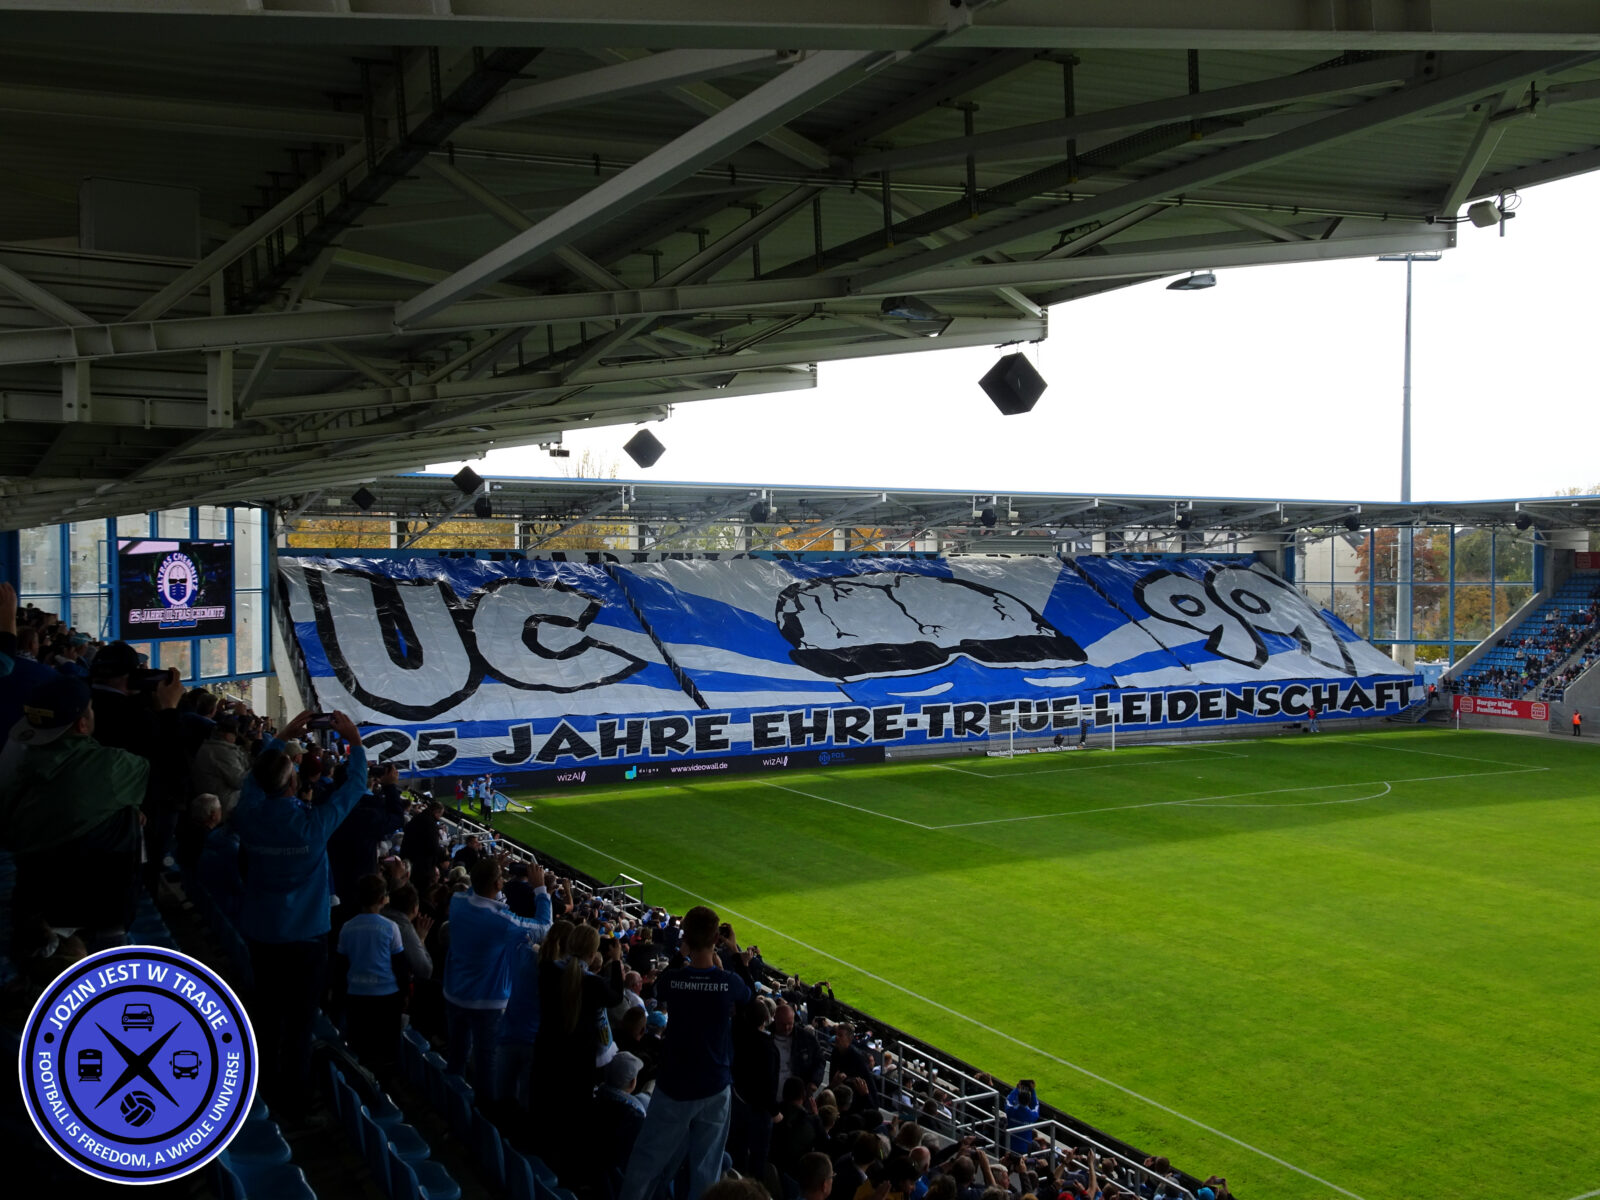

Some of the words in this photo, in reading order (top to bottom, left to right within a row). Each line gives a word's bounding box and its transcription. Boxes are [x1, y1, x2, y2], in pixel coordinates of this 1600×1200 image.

[157, 555, 173, 592] ULTRAS
[172, 552, 199, 591] CHEMNITZ
[142, 608, 165, 621] JAHRE
[165, 607, 192, 620] ULTRAS
[192, 606, 226, 619] CHEMNITZ
[1134, 564, 1357, 678] 99
[303, 566, 649, 721] UC
[1476, 699, 1497, 707] Burger
[1497, 700, 1513, 709] King
[1476, 706, 1501, 714] Familien
[1501, 707, 1519, 716] Block
[361, 728, 458, 771] 25
[491, 713, 732, 766] JAHRE
[670, 762, 729, 773] www.videowall.de
[670, 980, 718, 992] CHEMNITZER
[719, 982, 729, 992] FC
